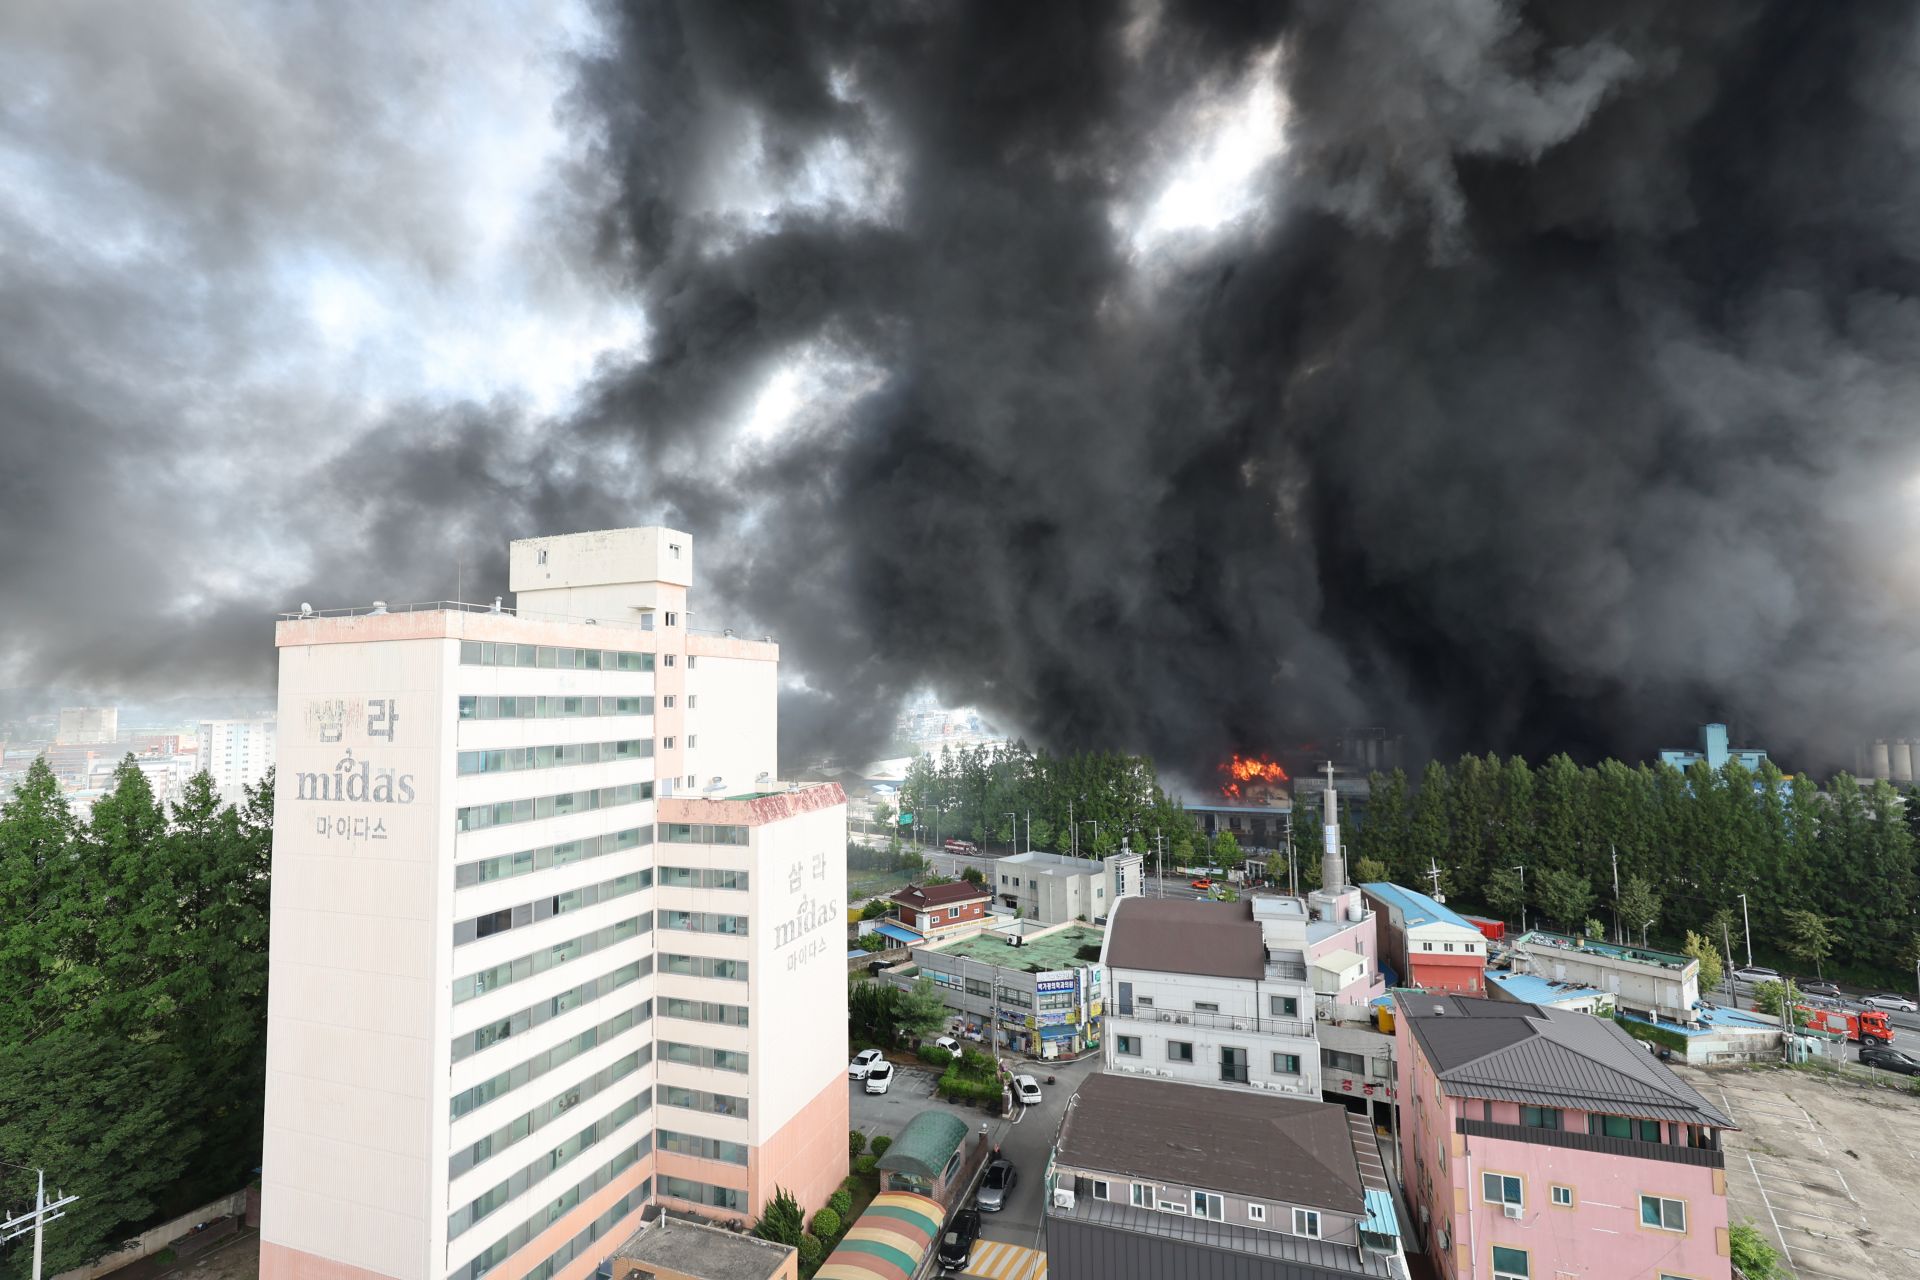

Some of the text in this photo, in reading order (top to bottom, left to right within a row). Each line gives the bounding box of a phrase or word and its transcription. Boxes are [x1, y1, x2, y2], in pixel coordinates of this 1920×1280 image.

[296, 747, 415, 804] midas
[316, 815, 388, 841] 마이다스
[774, 893, 837, 950] midas
[787, 936, 827, 971] 마이다스
